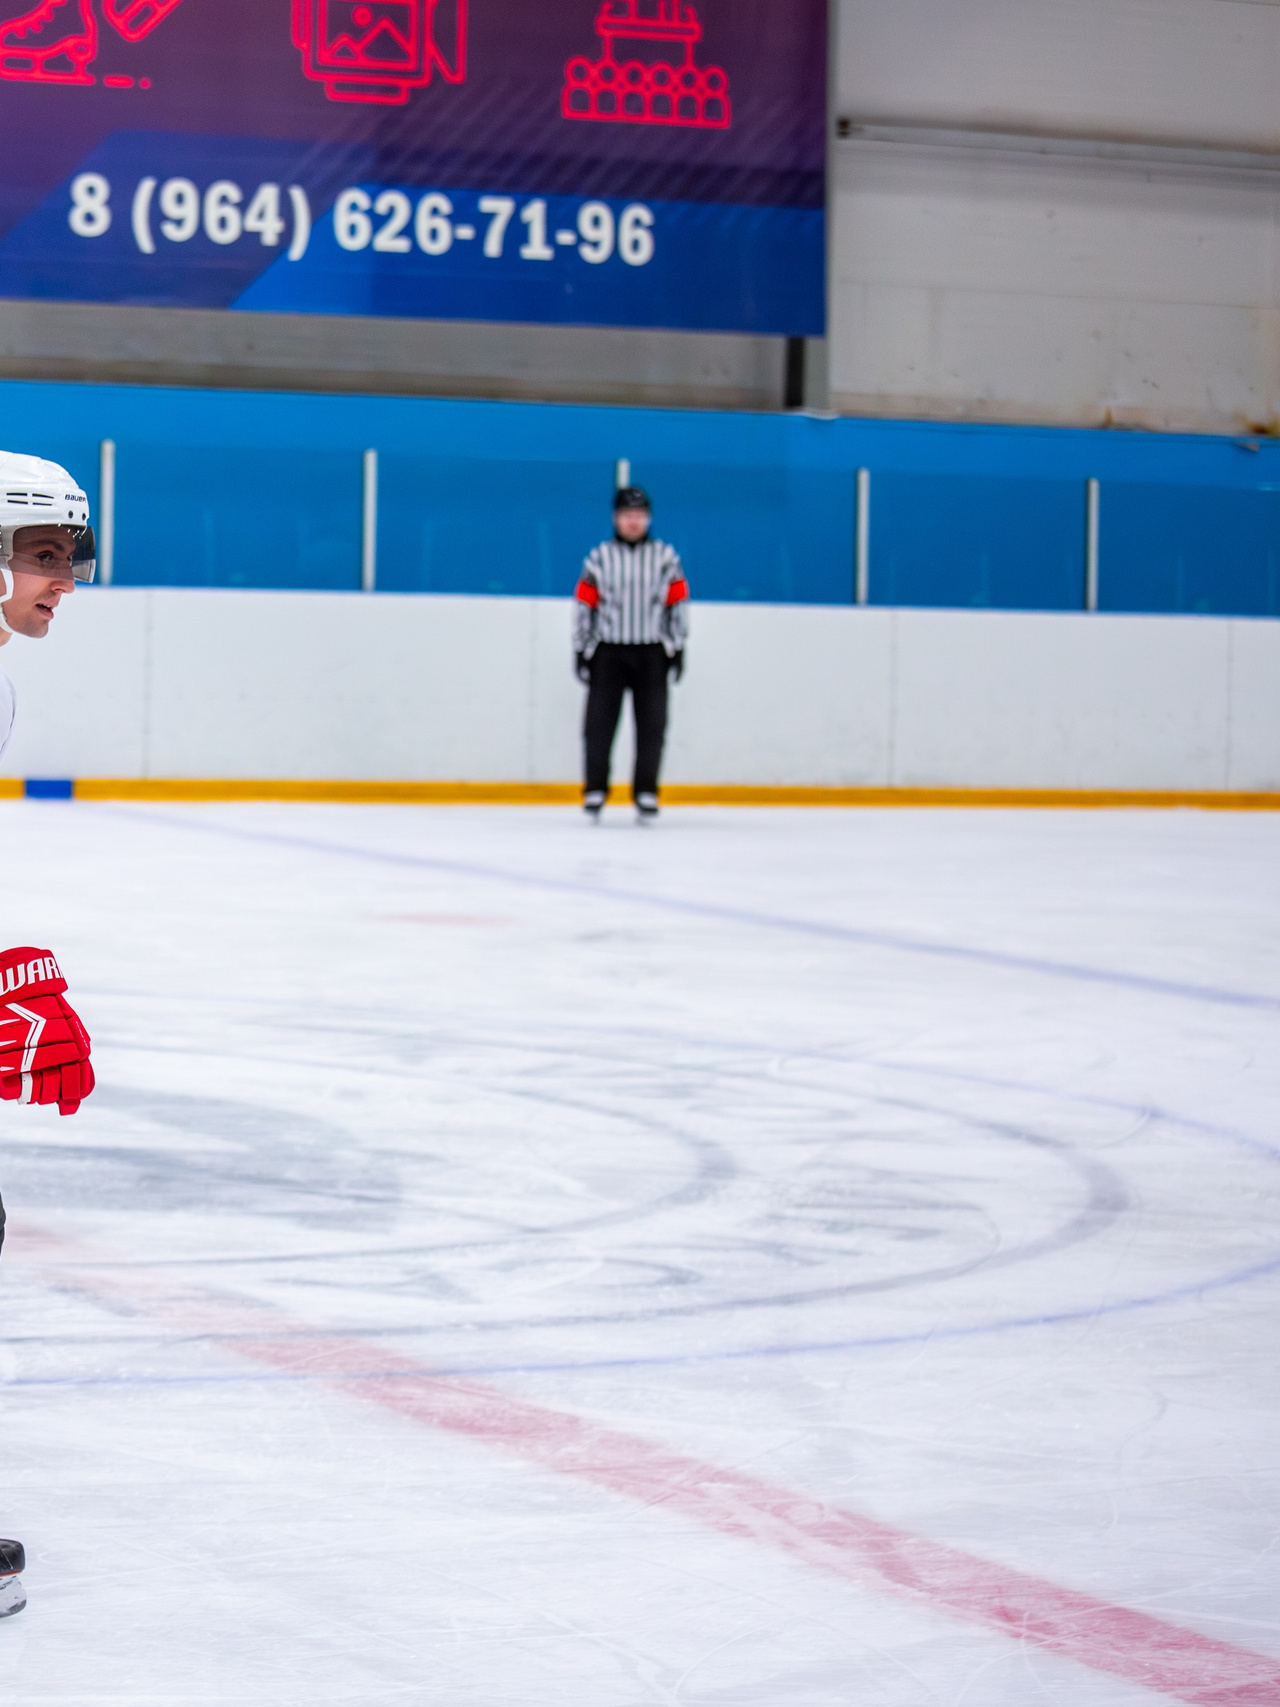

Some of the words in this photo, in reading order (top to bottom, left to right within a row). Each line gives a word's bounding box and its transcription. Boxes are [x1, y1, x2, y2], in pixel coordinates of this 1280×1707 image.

[69, 173, 111, 238] 8
[132, 178, 311, 262] (964)
[332, 188, 655, 266] 626-71-96
